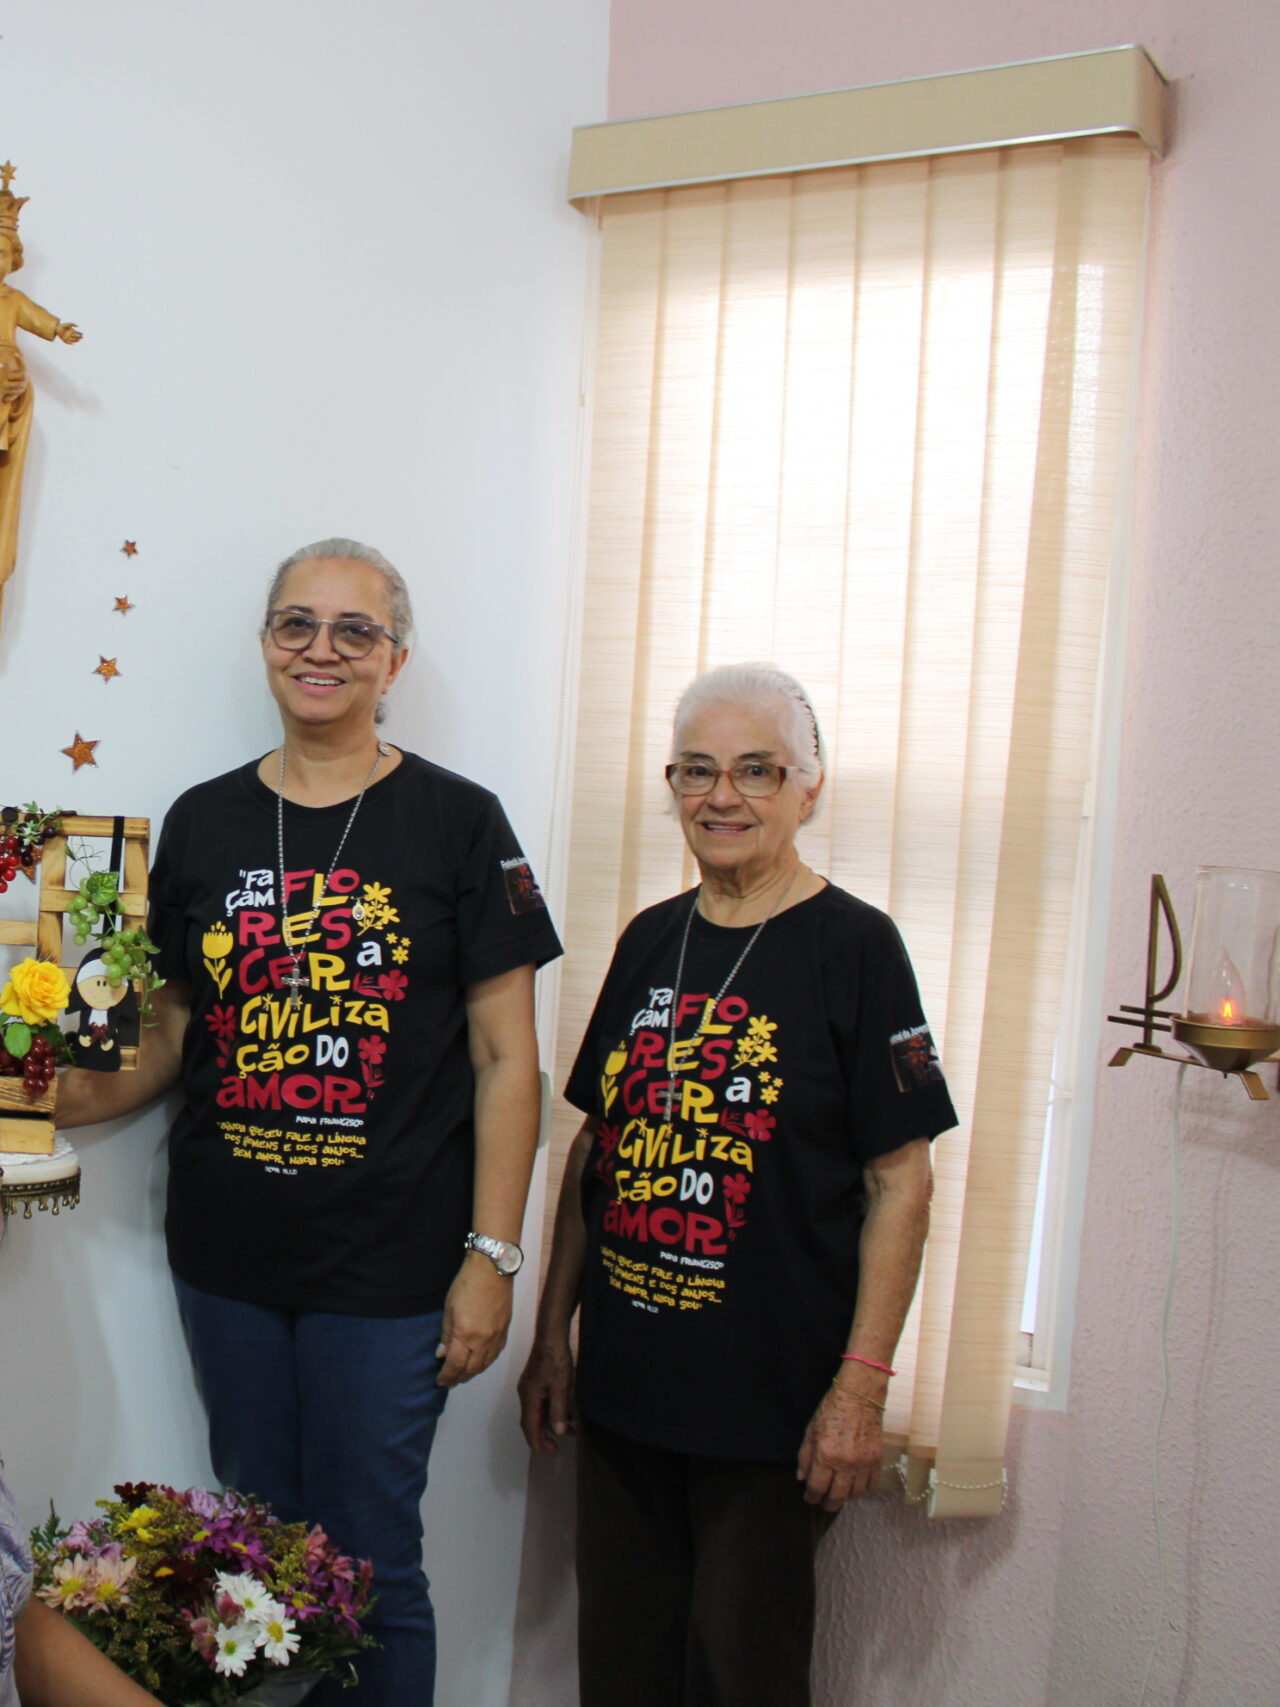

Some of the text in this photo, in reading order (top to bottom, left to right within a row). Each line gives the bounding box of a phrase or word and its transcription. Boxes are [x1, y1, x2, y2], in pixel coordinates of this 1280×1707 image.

[280, 868, 360, 907] FLO
[238, 908, 352, 950] RES
[238, 947, 351, 996] CER
[675, 993, 749, 1034] FLO
[316, 1035, 349, 1068] DO
[629, 1031, 734, 1080] RES
[623, 1069, 719, 1123] CER
[679, 1168, 713, 1205] DO
